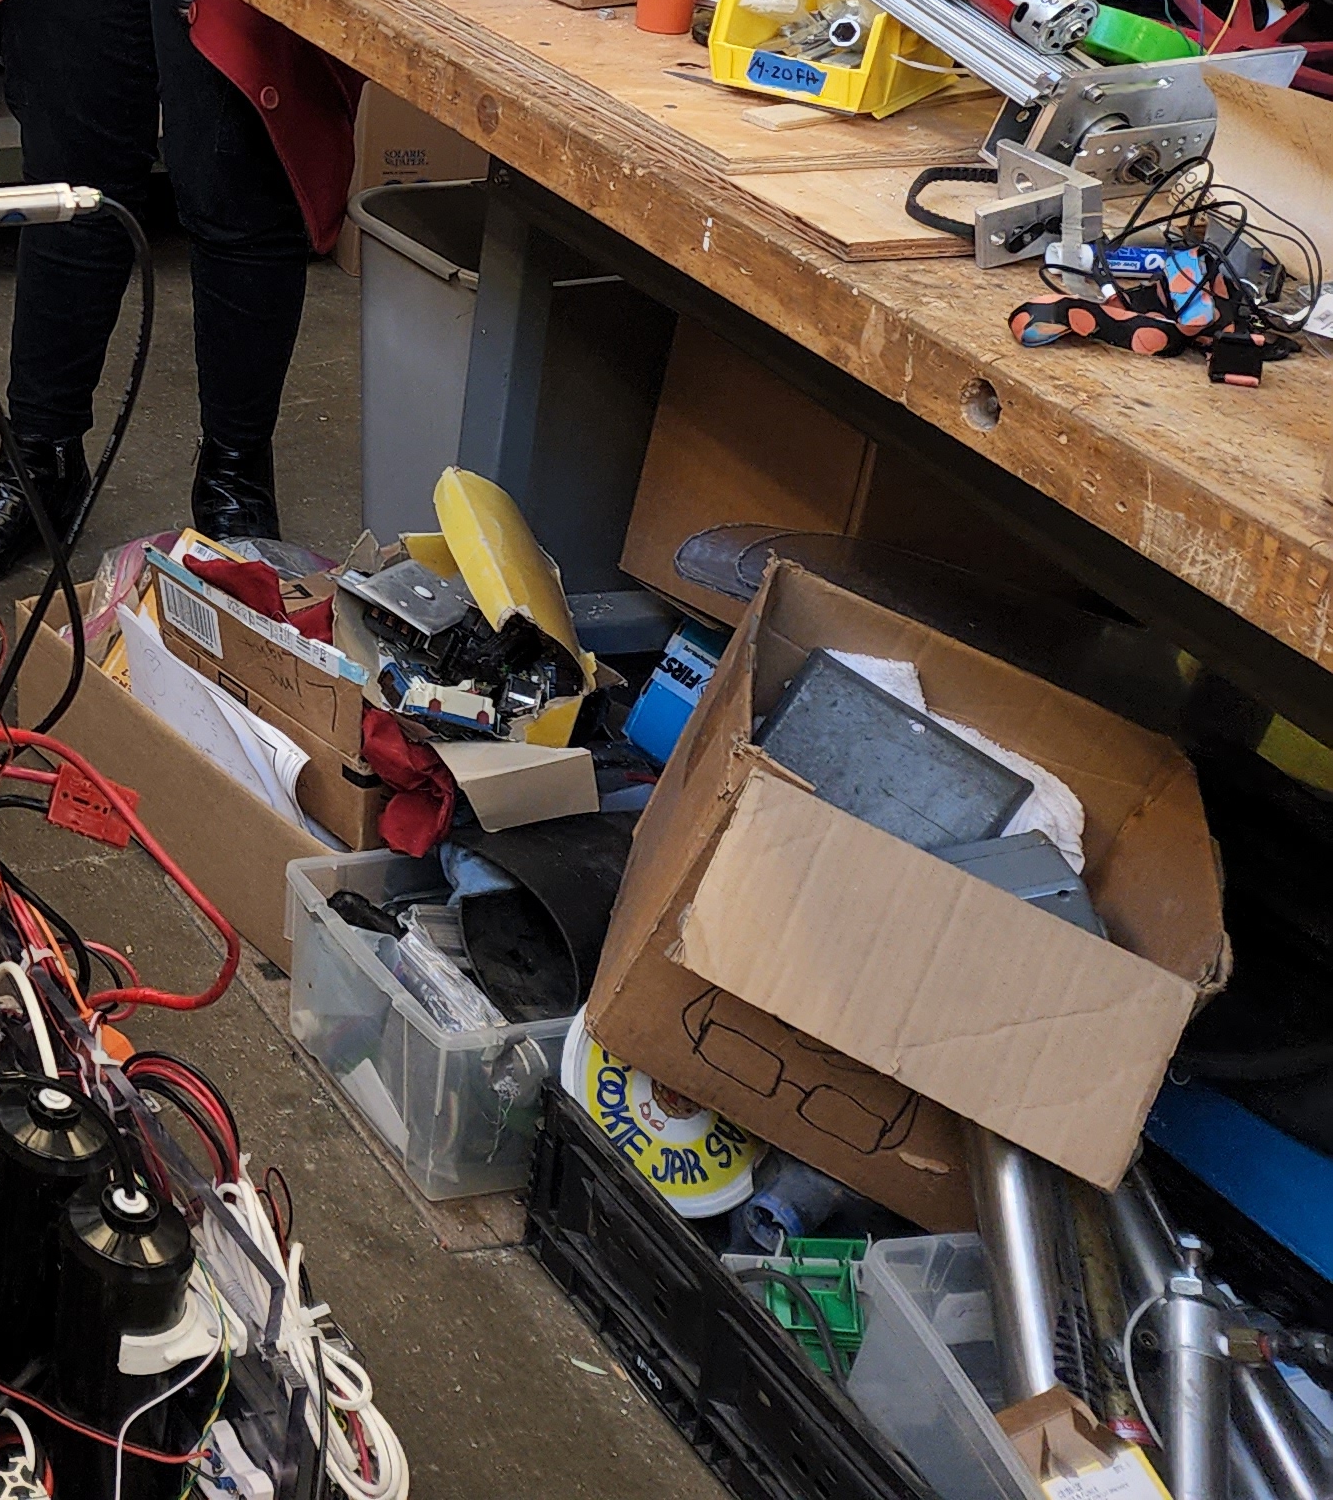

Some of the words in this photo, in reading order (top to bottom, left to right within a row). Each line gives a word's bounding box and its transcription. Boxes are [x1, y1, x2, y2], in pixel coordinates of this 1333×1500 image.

[384, 149, 426, 159] SOLARIS
[657, 656, 703, 690] FIRS
[596, 1064, 653, 1165] OOKIE
[651, 1147, 710, 1185] JAR
[636, 1355, 663, 1391] IFCO
